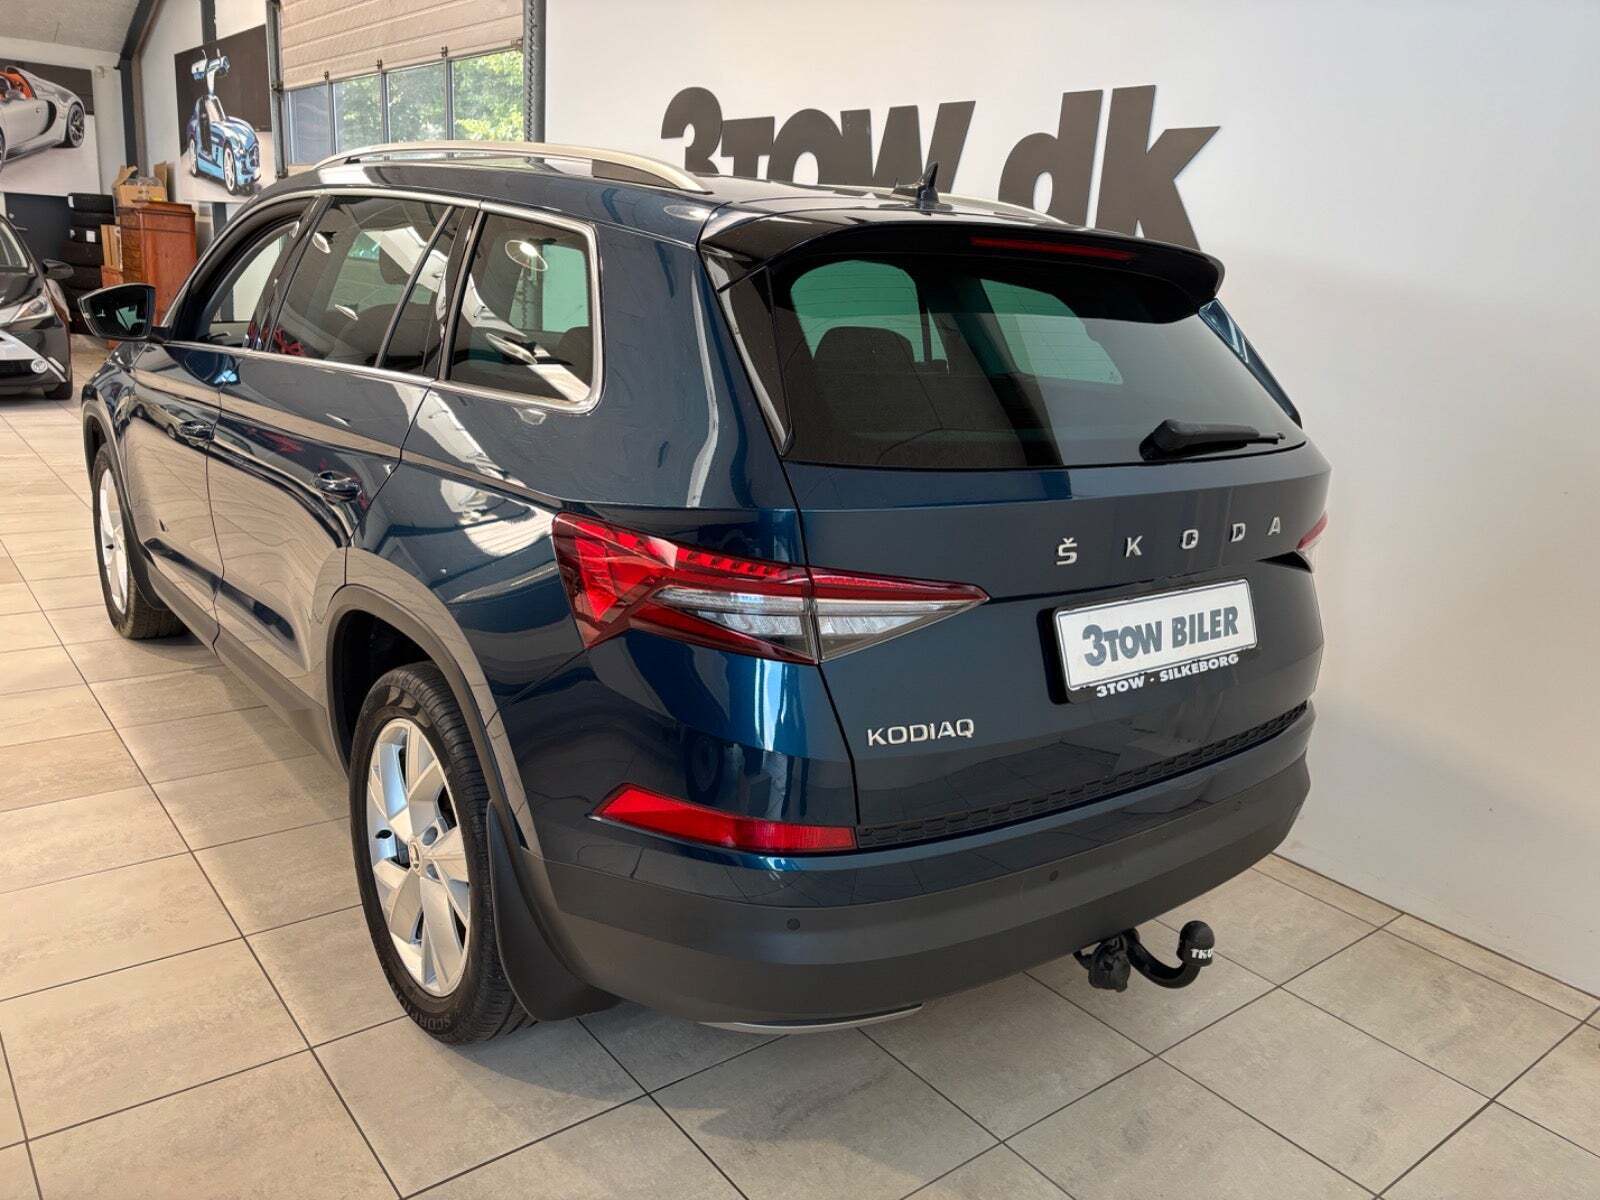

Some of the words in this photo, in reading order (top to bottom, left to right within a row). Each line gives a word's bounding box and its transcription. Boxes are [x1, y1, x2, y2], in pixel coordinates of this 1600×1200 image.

[1082, 620, 1163, 667] 3TOW
[1172, 606, 1239, 649] BILER
[1096, 675, 1145, 697] 3TOW
[1159, 653, 1239, 683] SILKEBORG
[867, 718, 975, 747] KODIAQ
